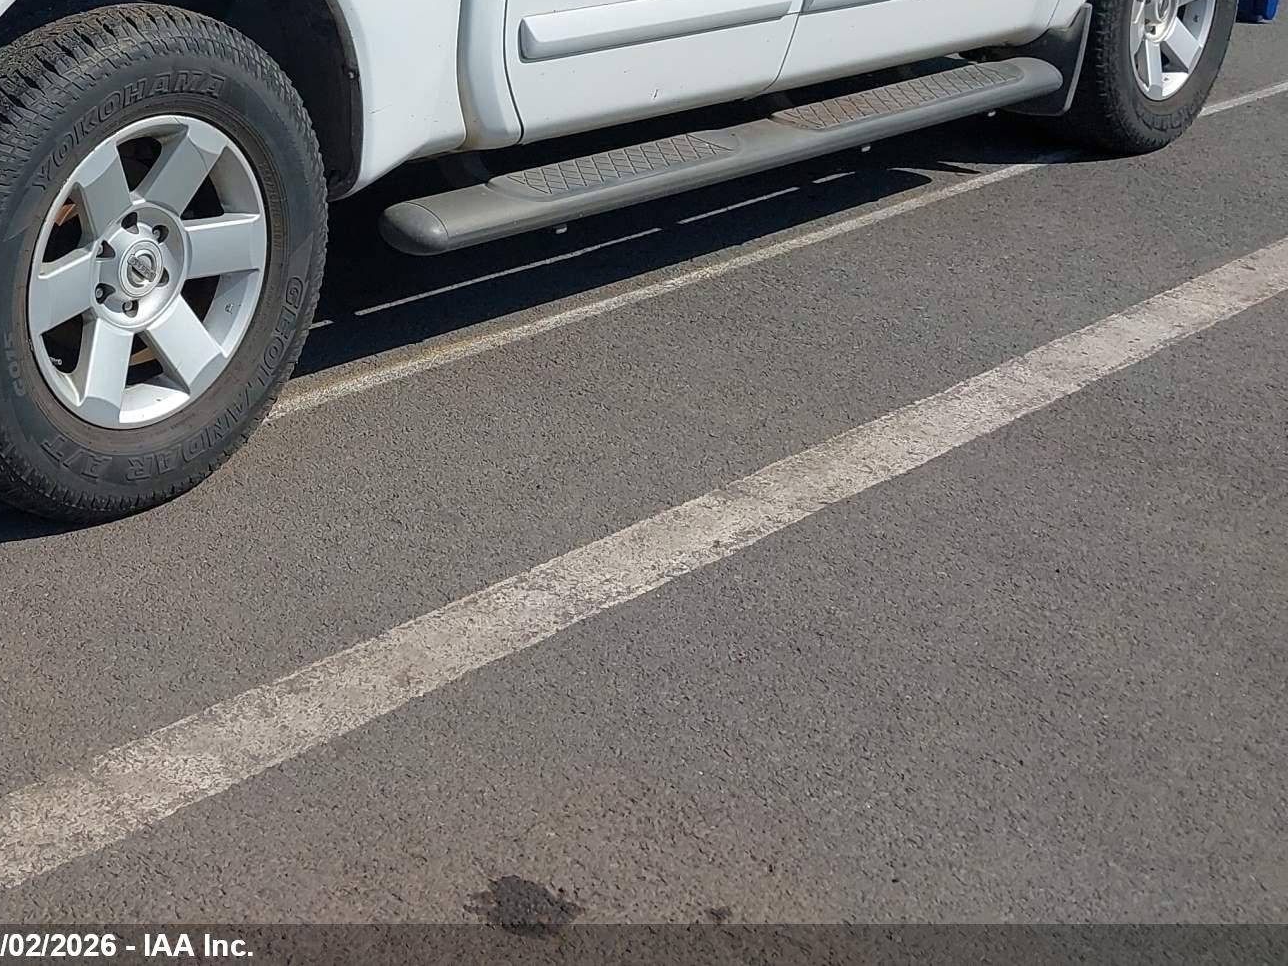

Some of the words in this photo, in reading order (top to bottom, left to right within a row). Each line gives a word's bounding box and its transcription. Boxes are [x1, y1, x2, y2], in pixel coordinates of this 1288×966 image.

[32, 70, 226, 191] YOKOHAMA
[126, 276, 304, 482] GEOLANDAR
[40, 435, 113, 479] A/T
